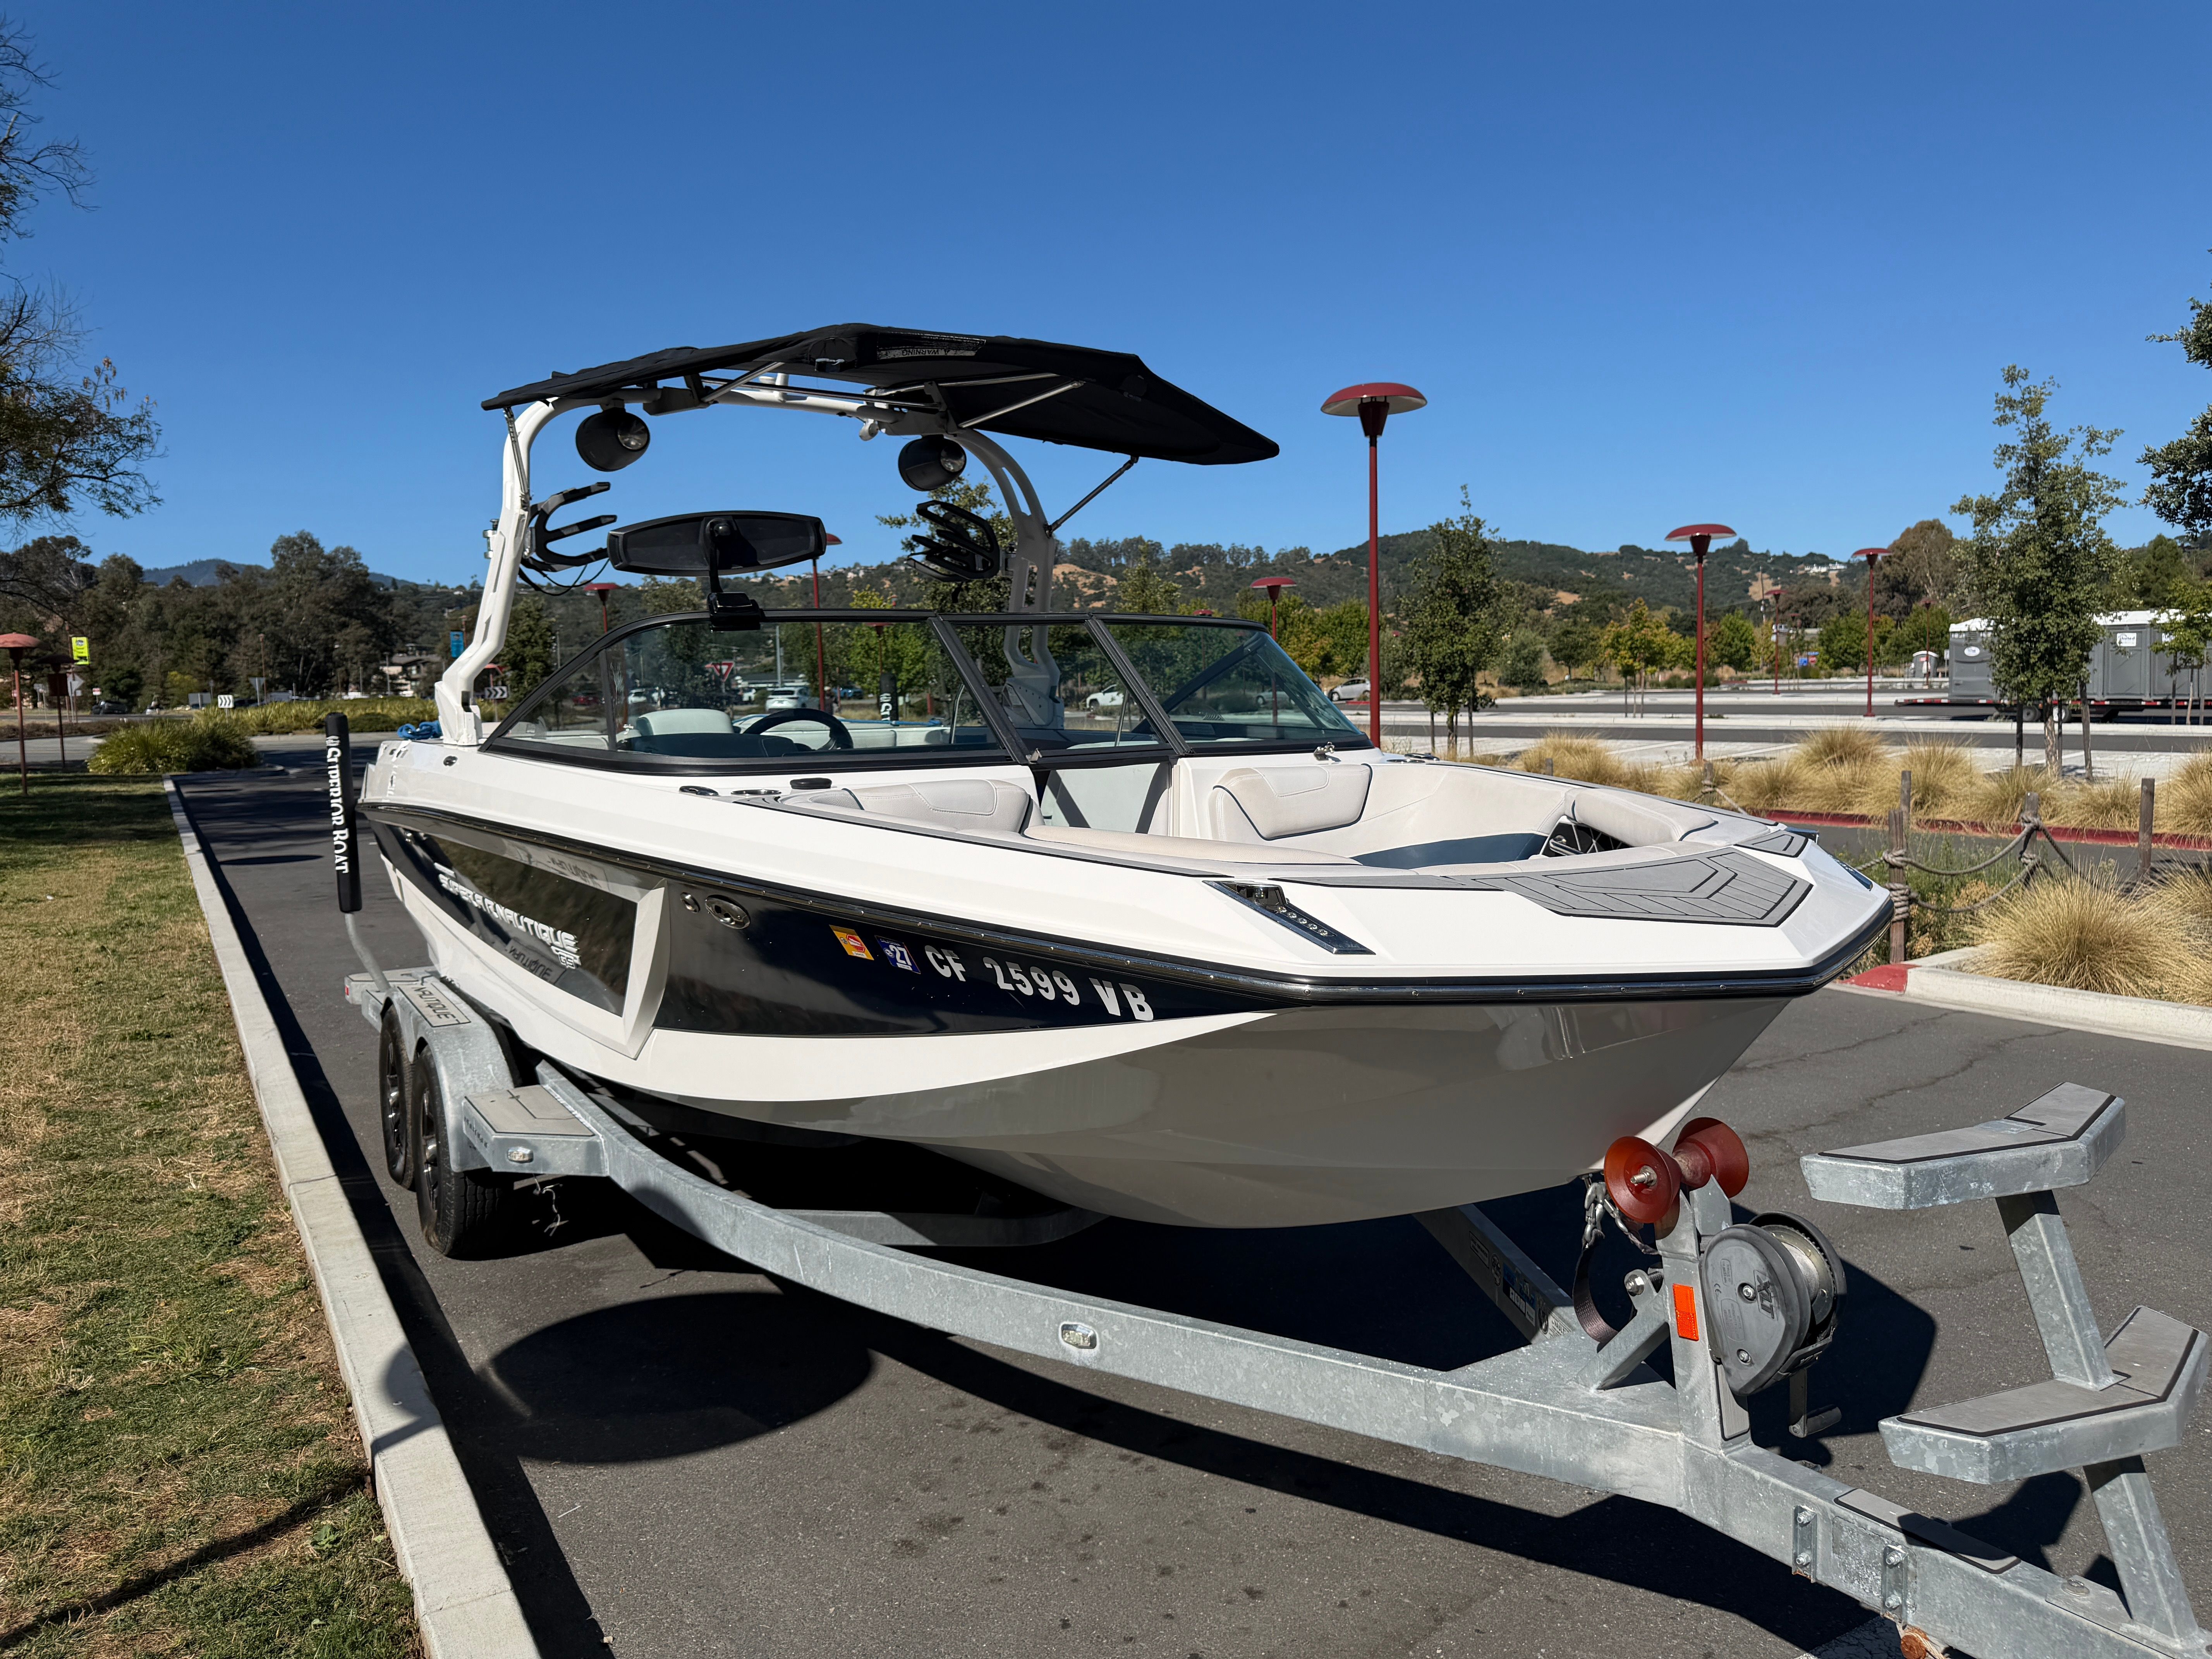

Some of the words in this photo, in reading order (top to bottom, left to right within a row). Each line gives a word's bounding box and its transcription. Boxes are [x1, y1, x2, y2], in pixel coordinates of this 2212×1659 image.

[495, 903, 580, 953] NAUTIQUE
[889, 945, 912, 966] 27
[924, 945, 967, 982] CF
[983, 956, 1080, 1006] 2599
[411, 987, 456, 1019] NAUTIQUE
[1757, 1274, 1774, 1319] XLT
